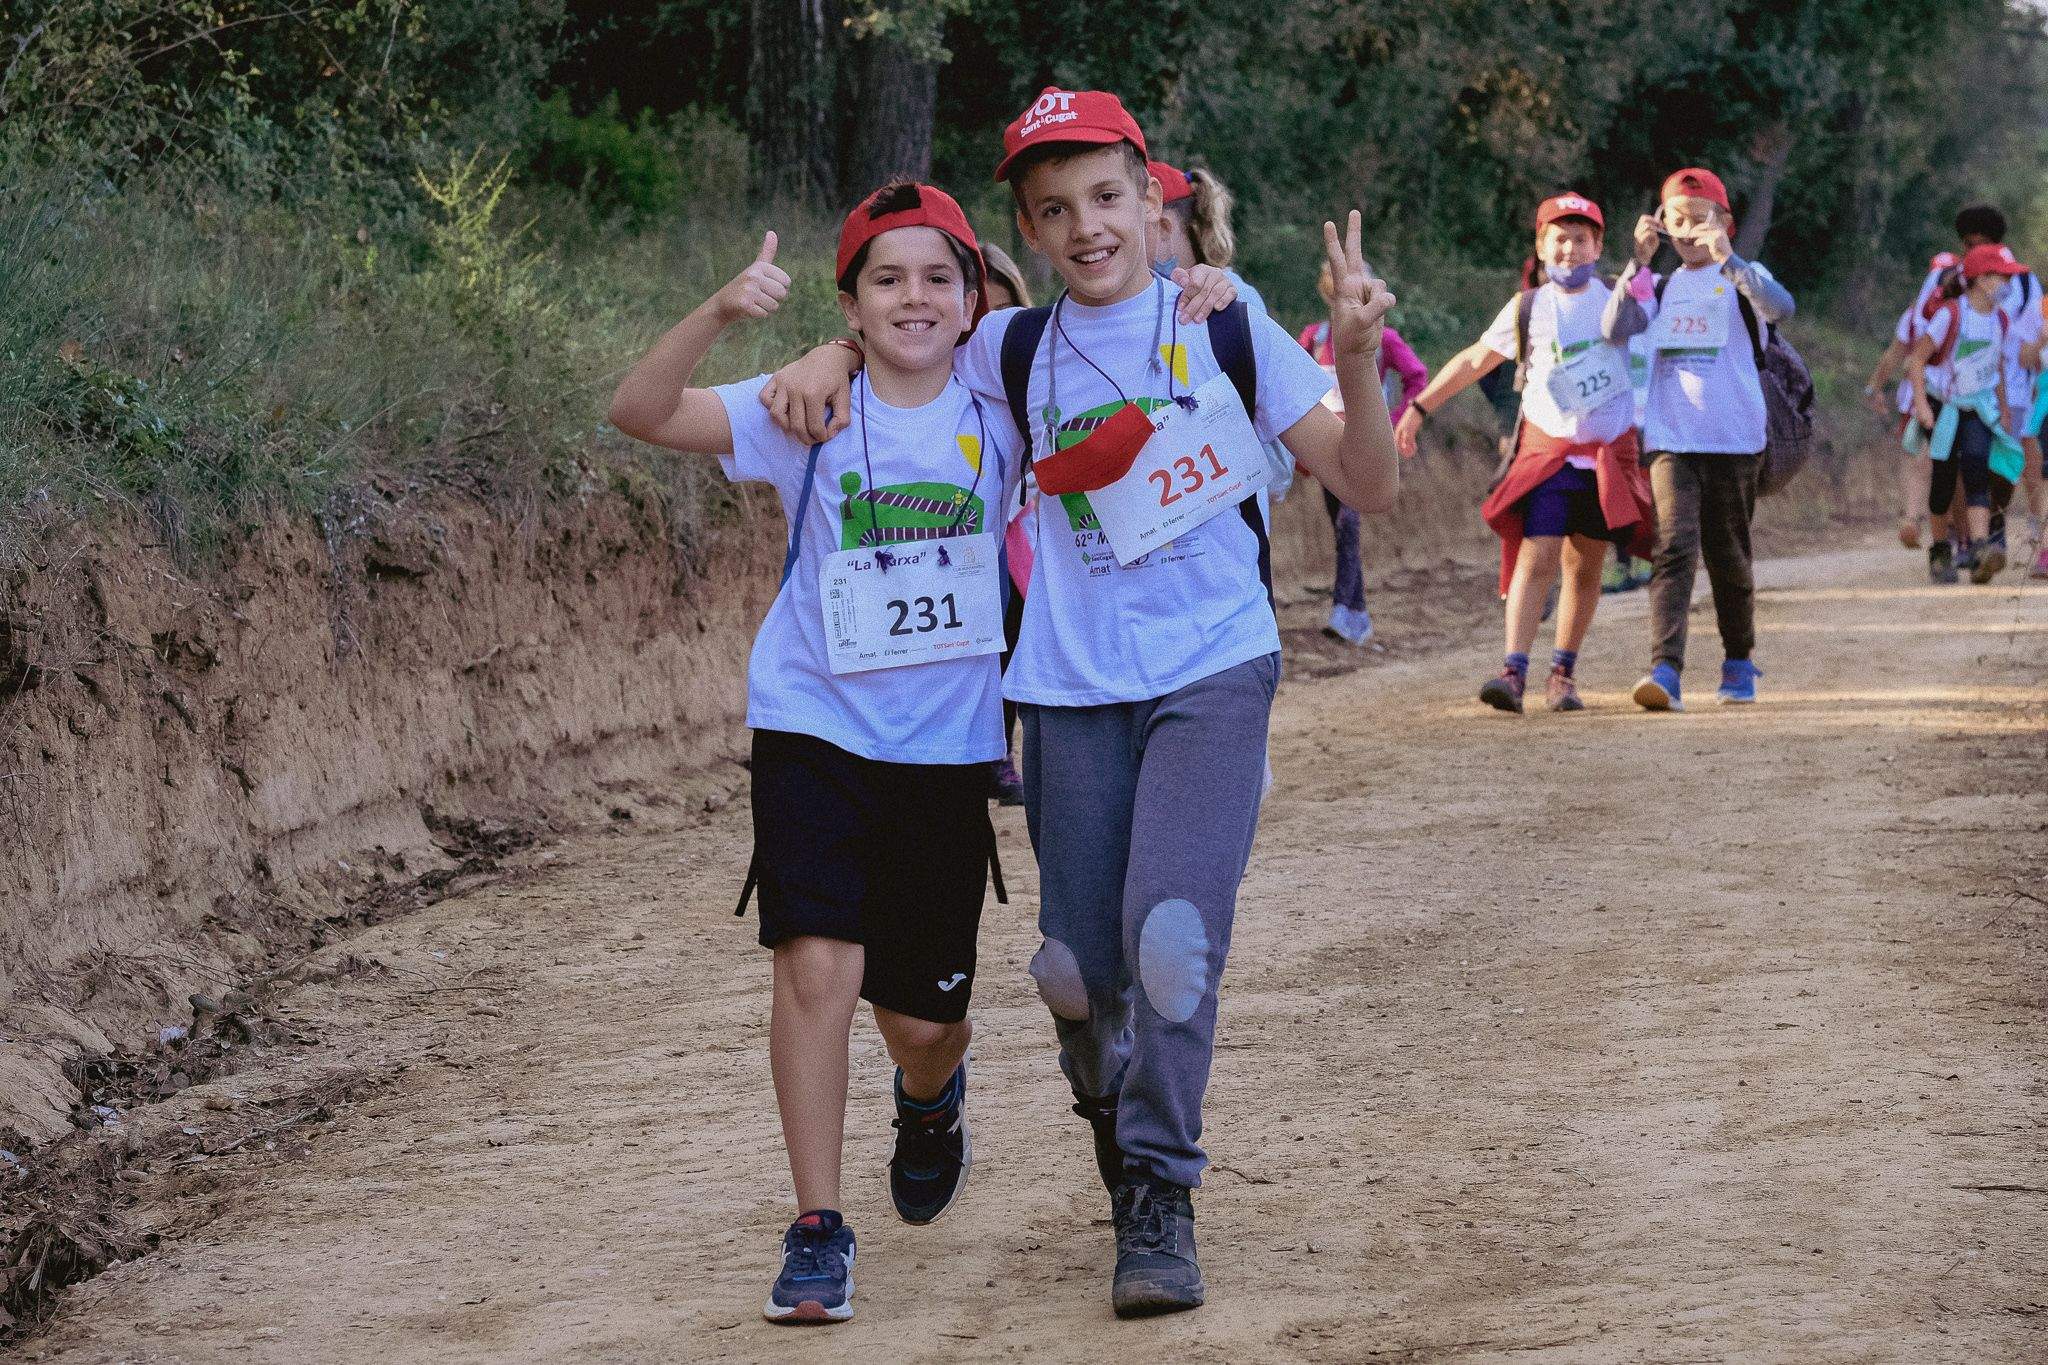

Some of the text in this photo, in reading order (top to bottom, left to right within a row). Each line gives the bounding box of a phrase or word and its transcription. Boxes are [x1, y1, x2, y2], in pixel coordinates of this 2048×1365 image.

[1025, 92, 1076, 125] TOT
[1020, 110, 1078, 138] Sant Cugat
[1672, 315, 1709, 334] 225
[1577, 370, 1612, 398] 225
[1148, 443, 1229, 507] 231
[833, 578, 847, 586] 231
[1089, 563, 1111, 574] Amat
[886, 592, 963, 636] 231
